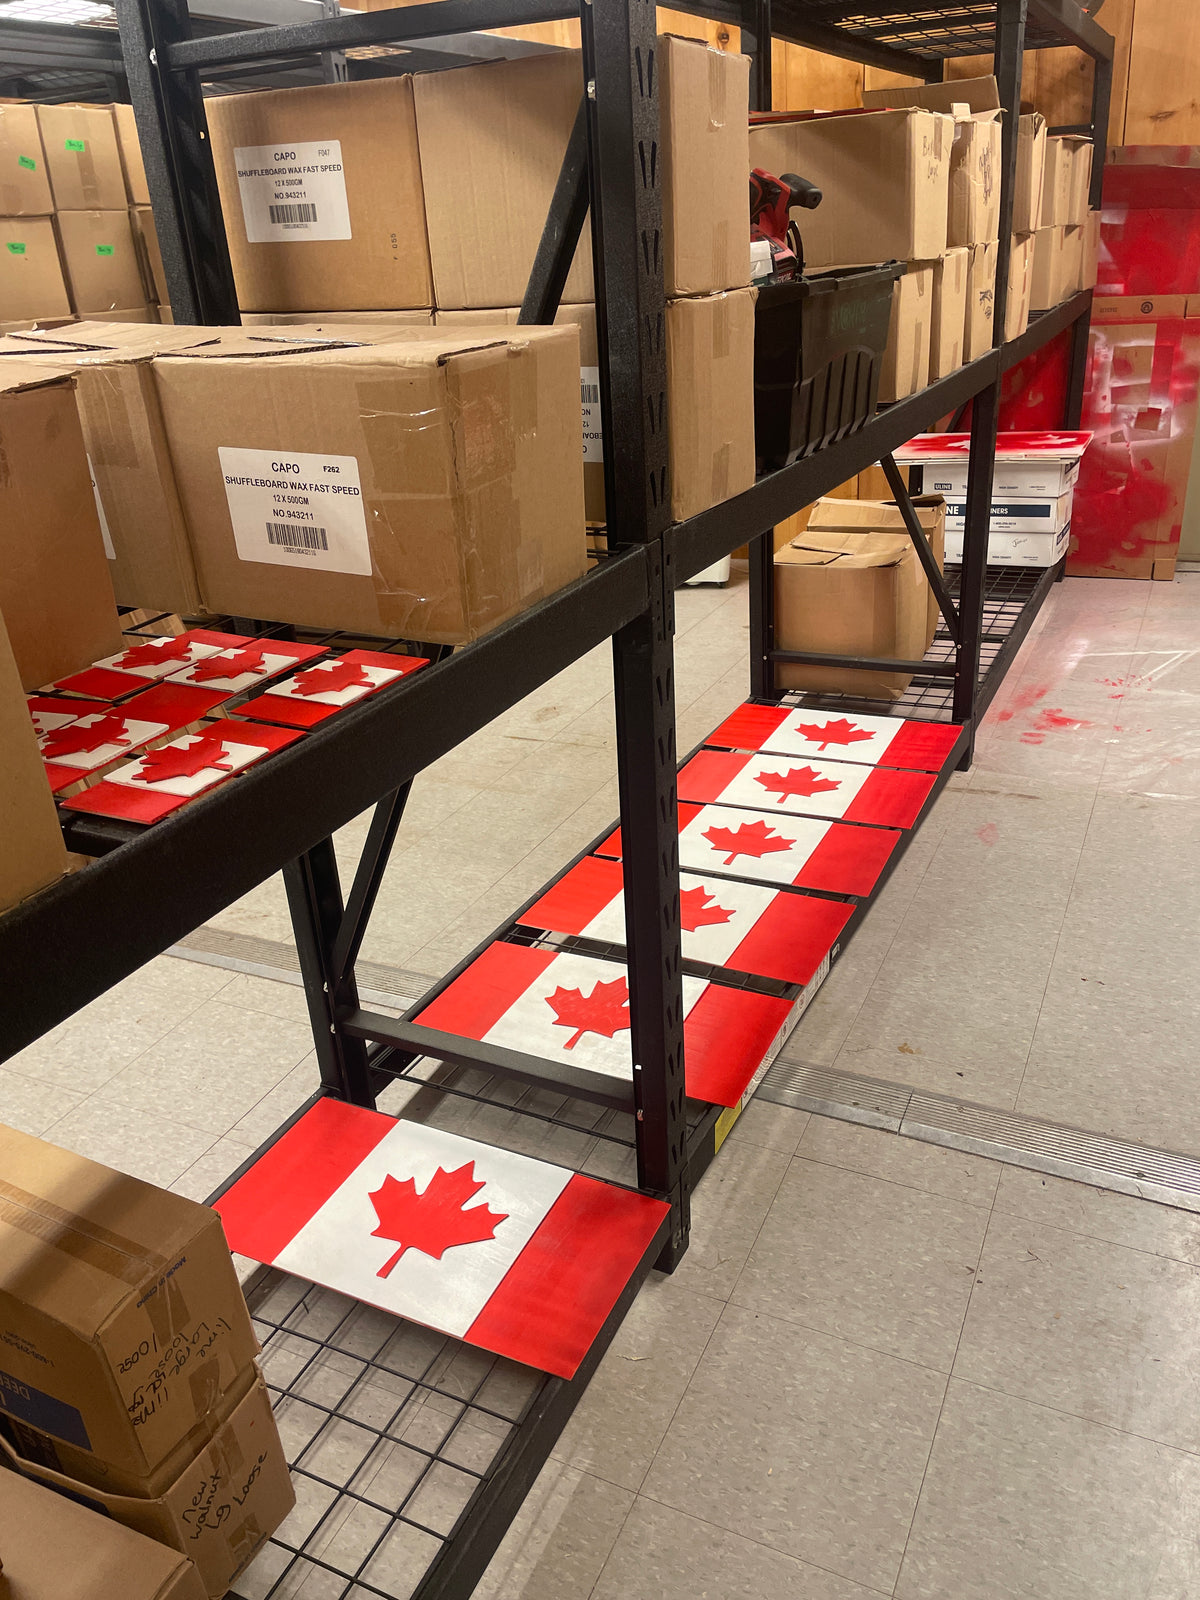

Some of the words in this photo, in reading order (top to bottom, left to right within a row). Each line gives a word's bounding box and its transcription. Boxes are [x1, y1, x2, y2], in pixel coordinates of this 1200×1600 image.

[273, 151, 297, 162] CAPO
[238, 167, 287, 178] SHUFFLEBOARD
[288, 165, 303, 175] WAX
[303, 164, 319, 173] FAST
[320, 163, 342, 173] SPEED
[286, 178, 303, 187] 500GM
[271, 462, 300, 474] CAPO
[323, 465, 341, 474] F262
[225, 475, 288, 490] SHUFFLEBOARD
[289, 481, 309, 492] WAX
[309, 483, 331, 494] FAST
[332, 485, 360, 496] SPEED
[272, 494, 281, 503] 12
[287, 495, 310, 505] 500GM
